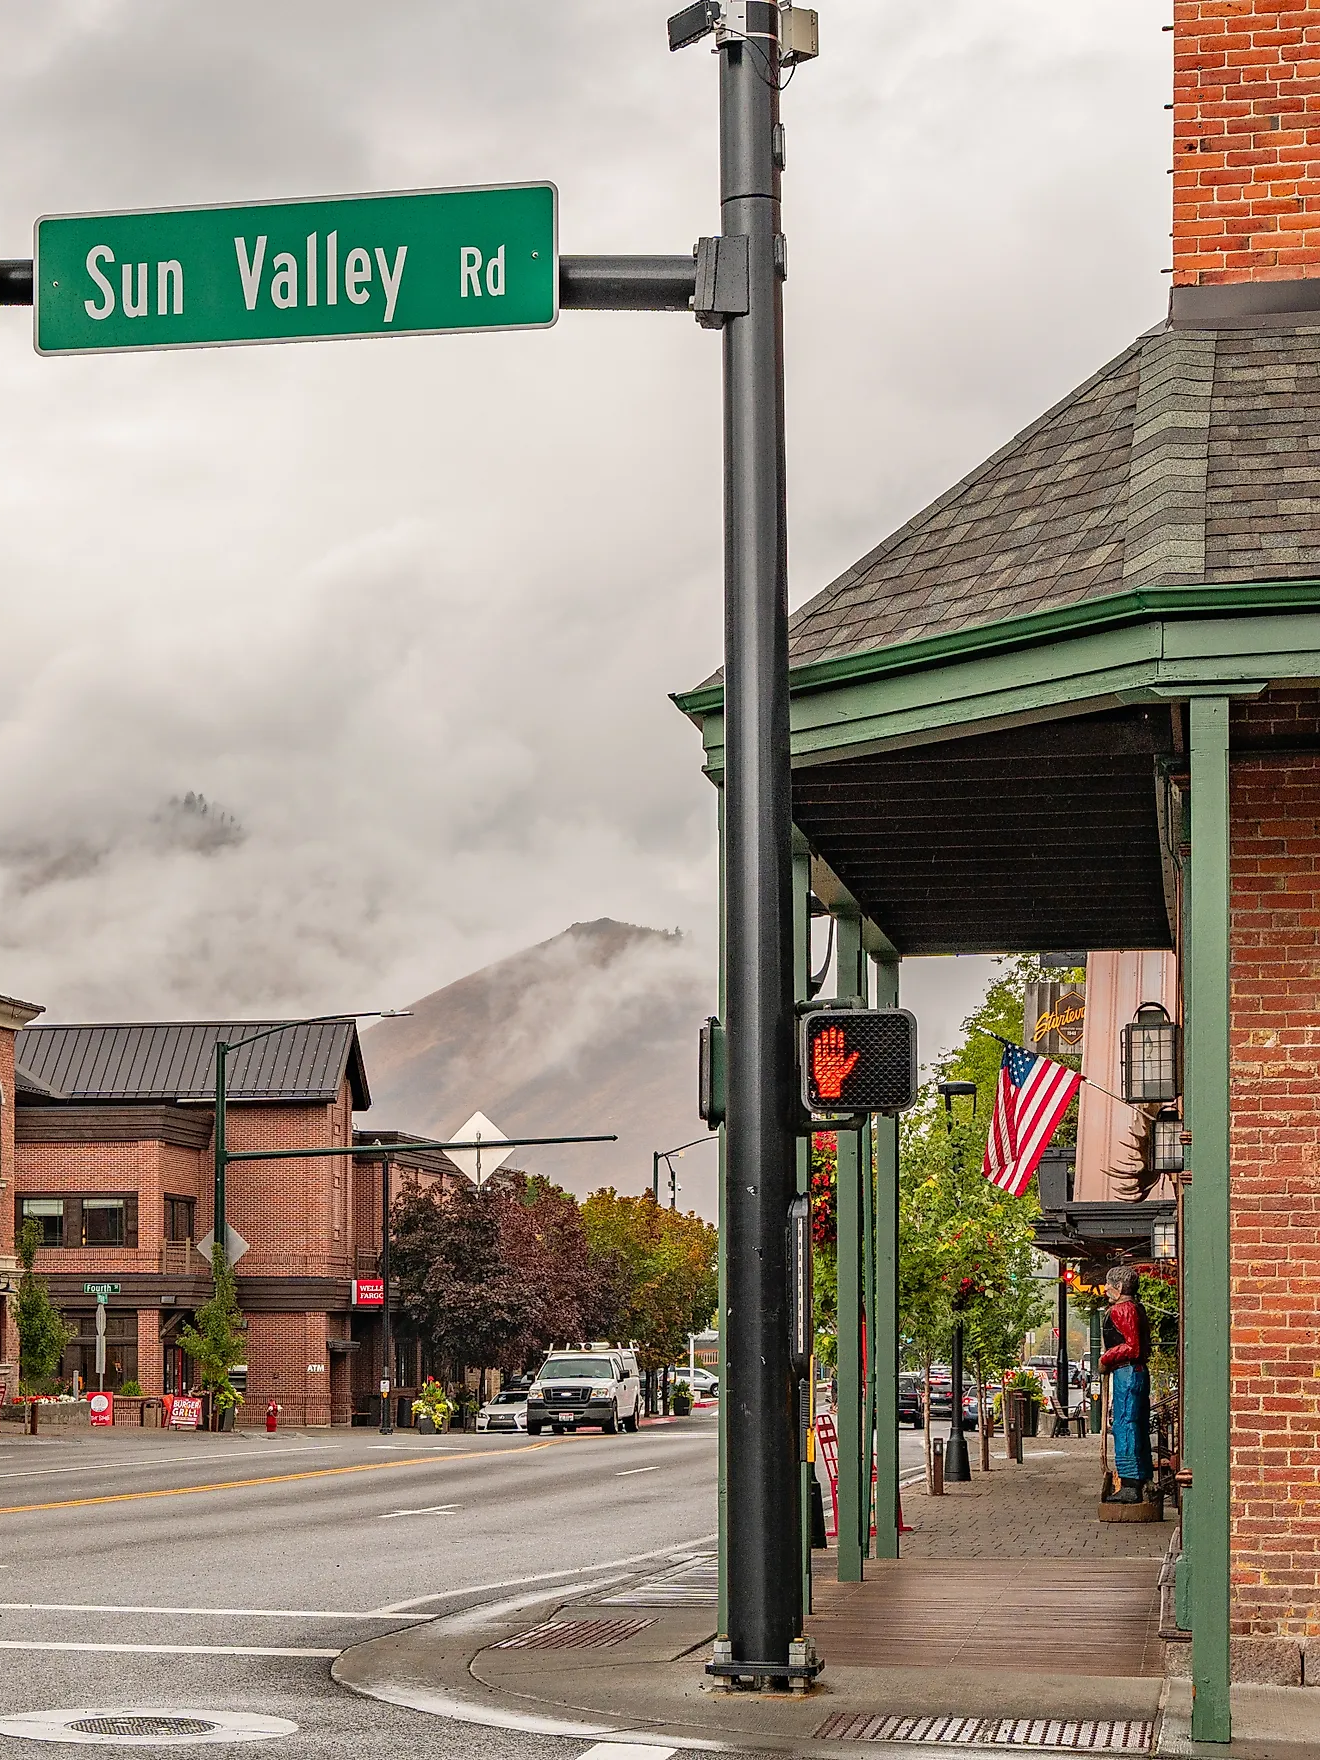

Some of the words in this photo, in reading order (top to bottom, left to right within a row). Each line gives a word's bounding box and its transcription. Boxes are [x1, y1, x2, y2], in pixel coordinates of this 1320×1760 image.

[85, 245, 183, 319] Sun
[235, 231, 407, 322] Valley
[461, 245, 504, 297] Rd
[87, 1284, 112, 1292] Fourth
[307, 1364, 325, 1372] ATM
[173, 1400, 199, 1409] BURGER
[172, 1408, 198, 1417] GRILL
